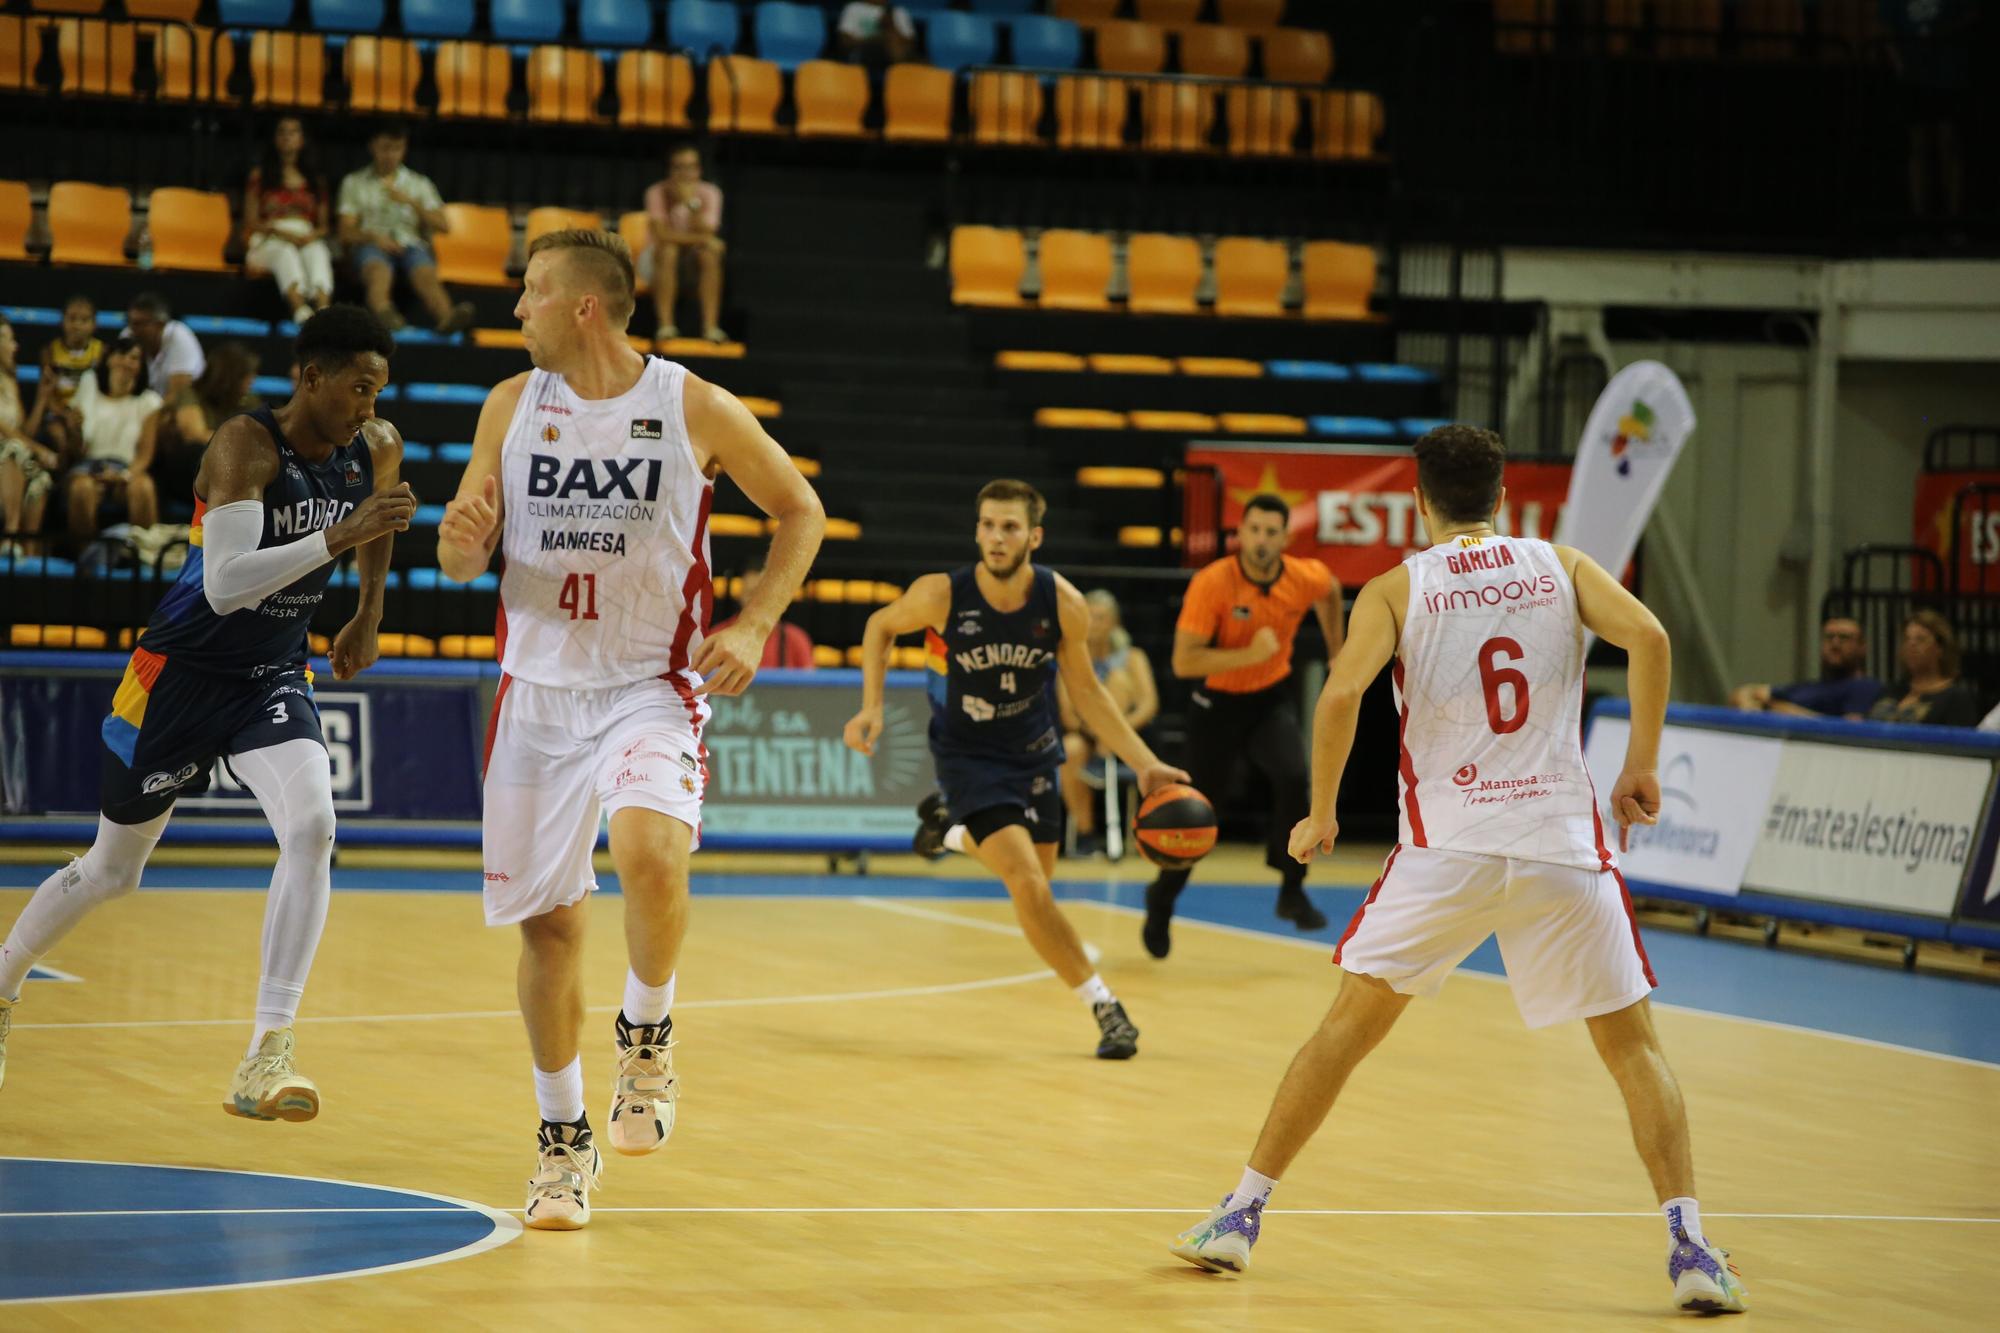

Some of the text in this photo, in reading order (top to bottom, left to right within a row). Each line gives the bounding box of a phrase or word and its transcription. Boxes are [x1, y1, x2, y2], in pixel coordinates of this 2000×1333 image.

[527, 453, 663, 502] BAXI
[527, 502, 655, 521] CLIMATIZACIÓN
[540, 529, 626, 557] MANRESA
[558, 573, 600, 621] 41
[1423, 575, 1556, 615] inmoovs
[1506, 597, 1558, 614] by AVINENT
[1000, 671, 1018, 694] 4
[1478, 636, 1530, 735] 6
[266, 701, 289, 724] 3
[1480, 775, 1538, 791] Manresa
[1461, 787, 1552, 808] Transforma
[1765, 797, 1971, 874] #matealestigma
